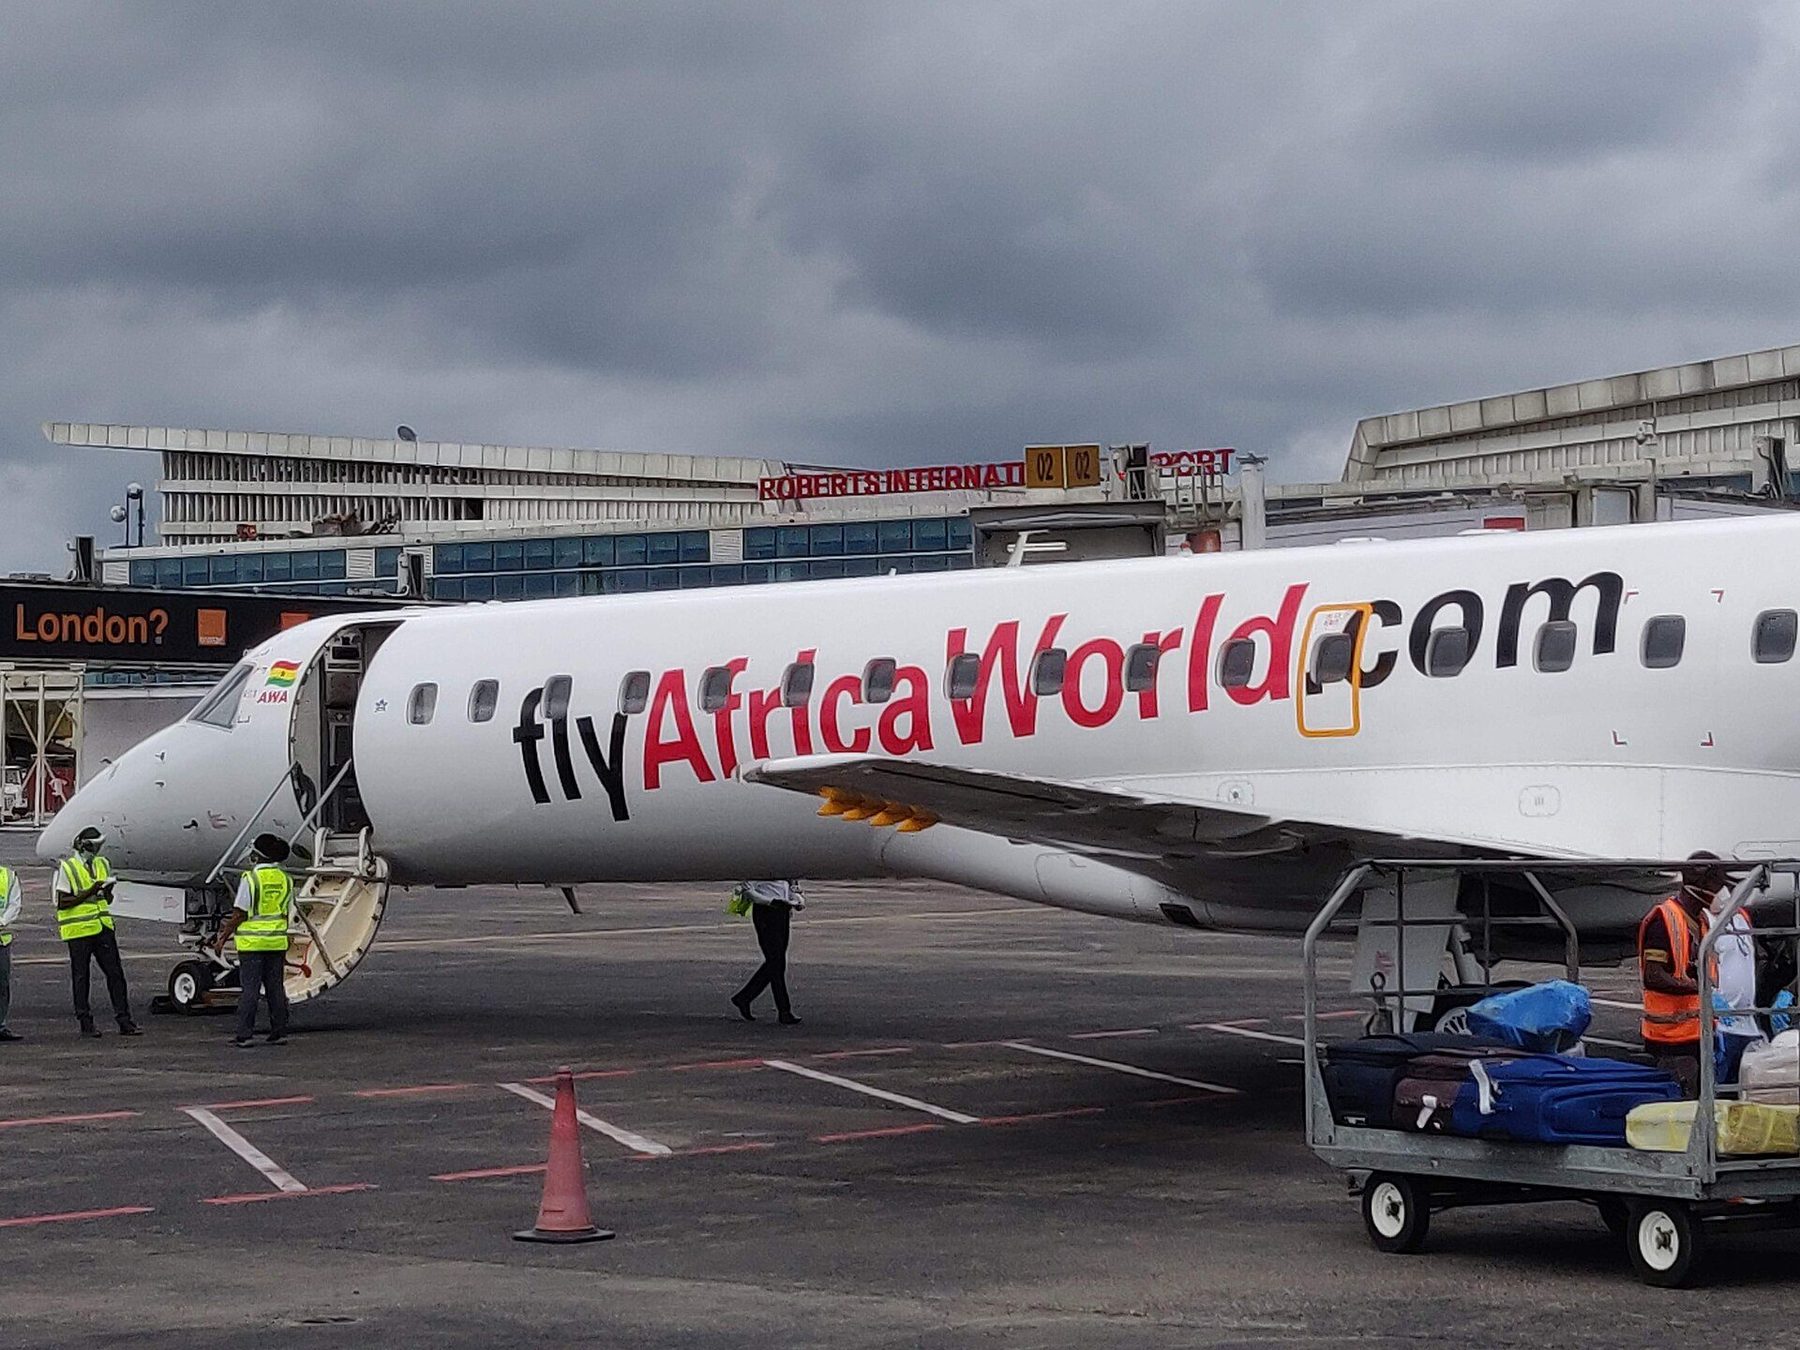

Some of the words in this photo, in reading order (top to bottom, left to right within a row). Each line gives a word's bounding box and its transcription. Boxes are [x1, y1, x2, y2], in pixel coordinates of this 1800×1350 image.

[1036, 452, 1054, 481] 02
[1074, 450, 1091, 480] 02
[760, 471, 881, 500] ROBERTS
[886, 461, 1026, 494] INTERNATI
[16, 604, 169, 645] London?
[257, 690, 288, 704] AWA
